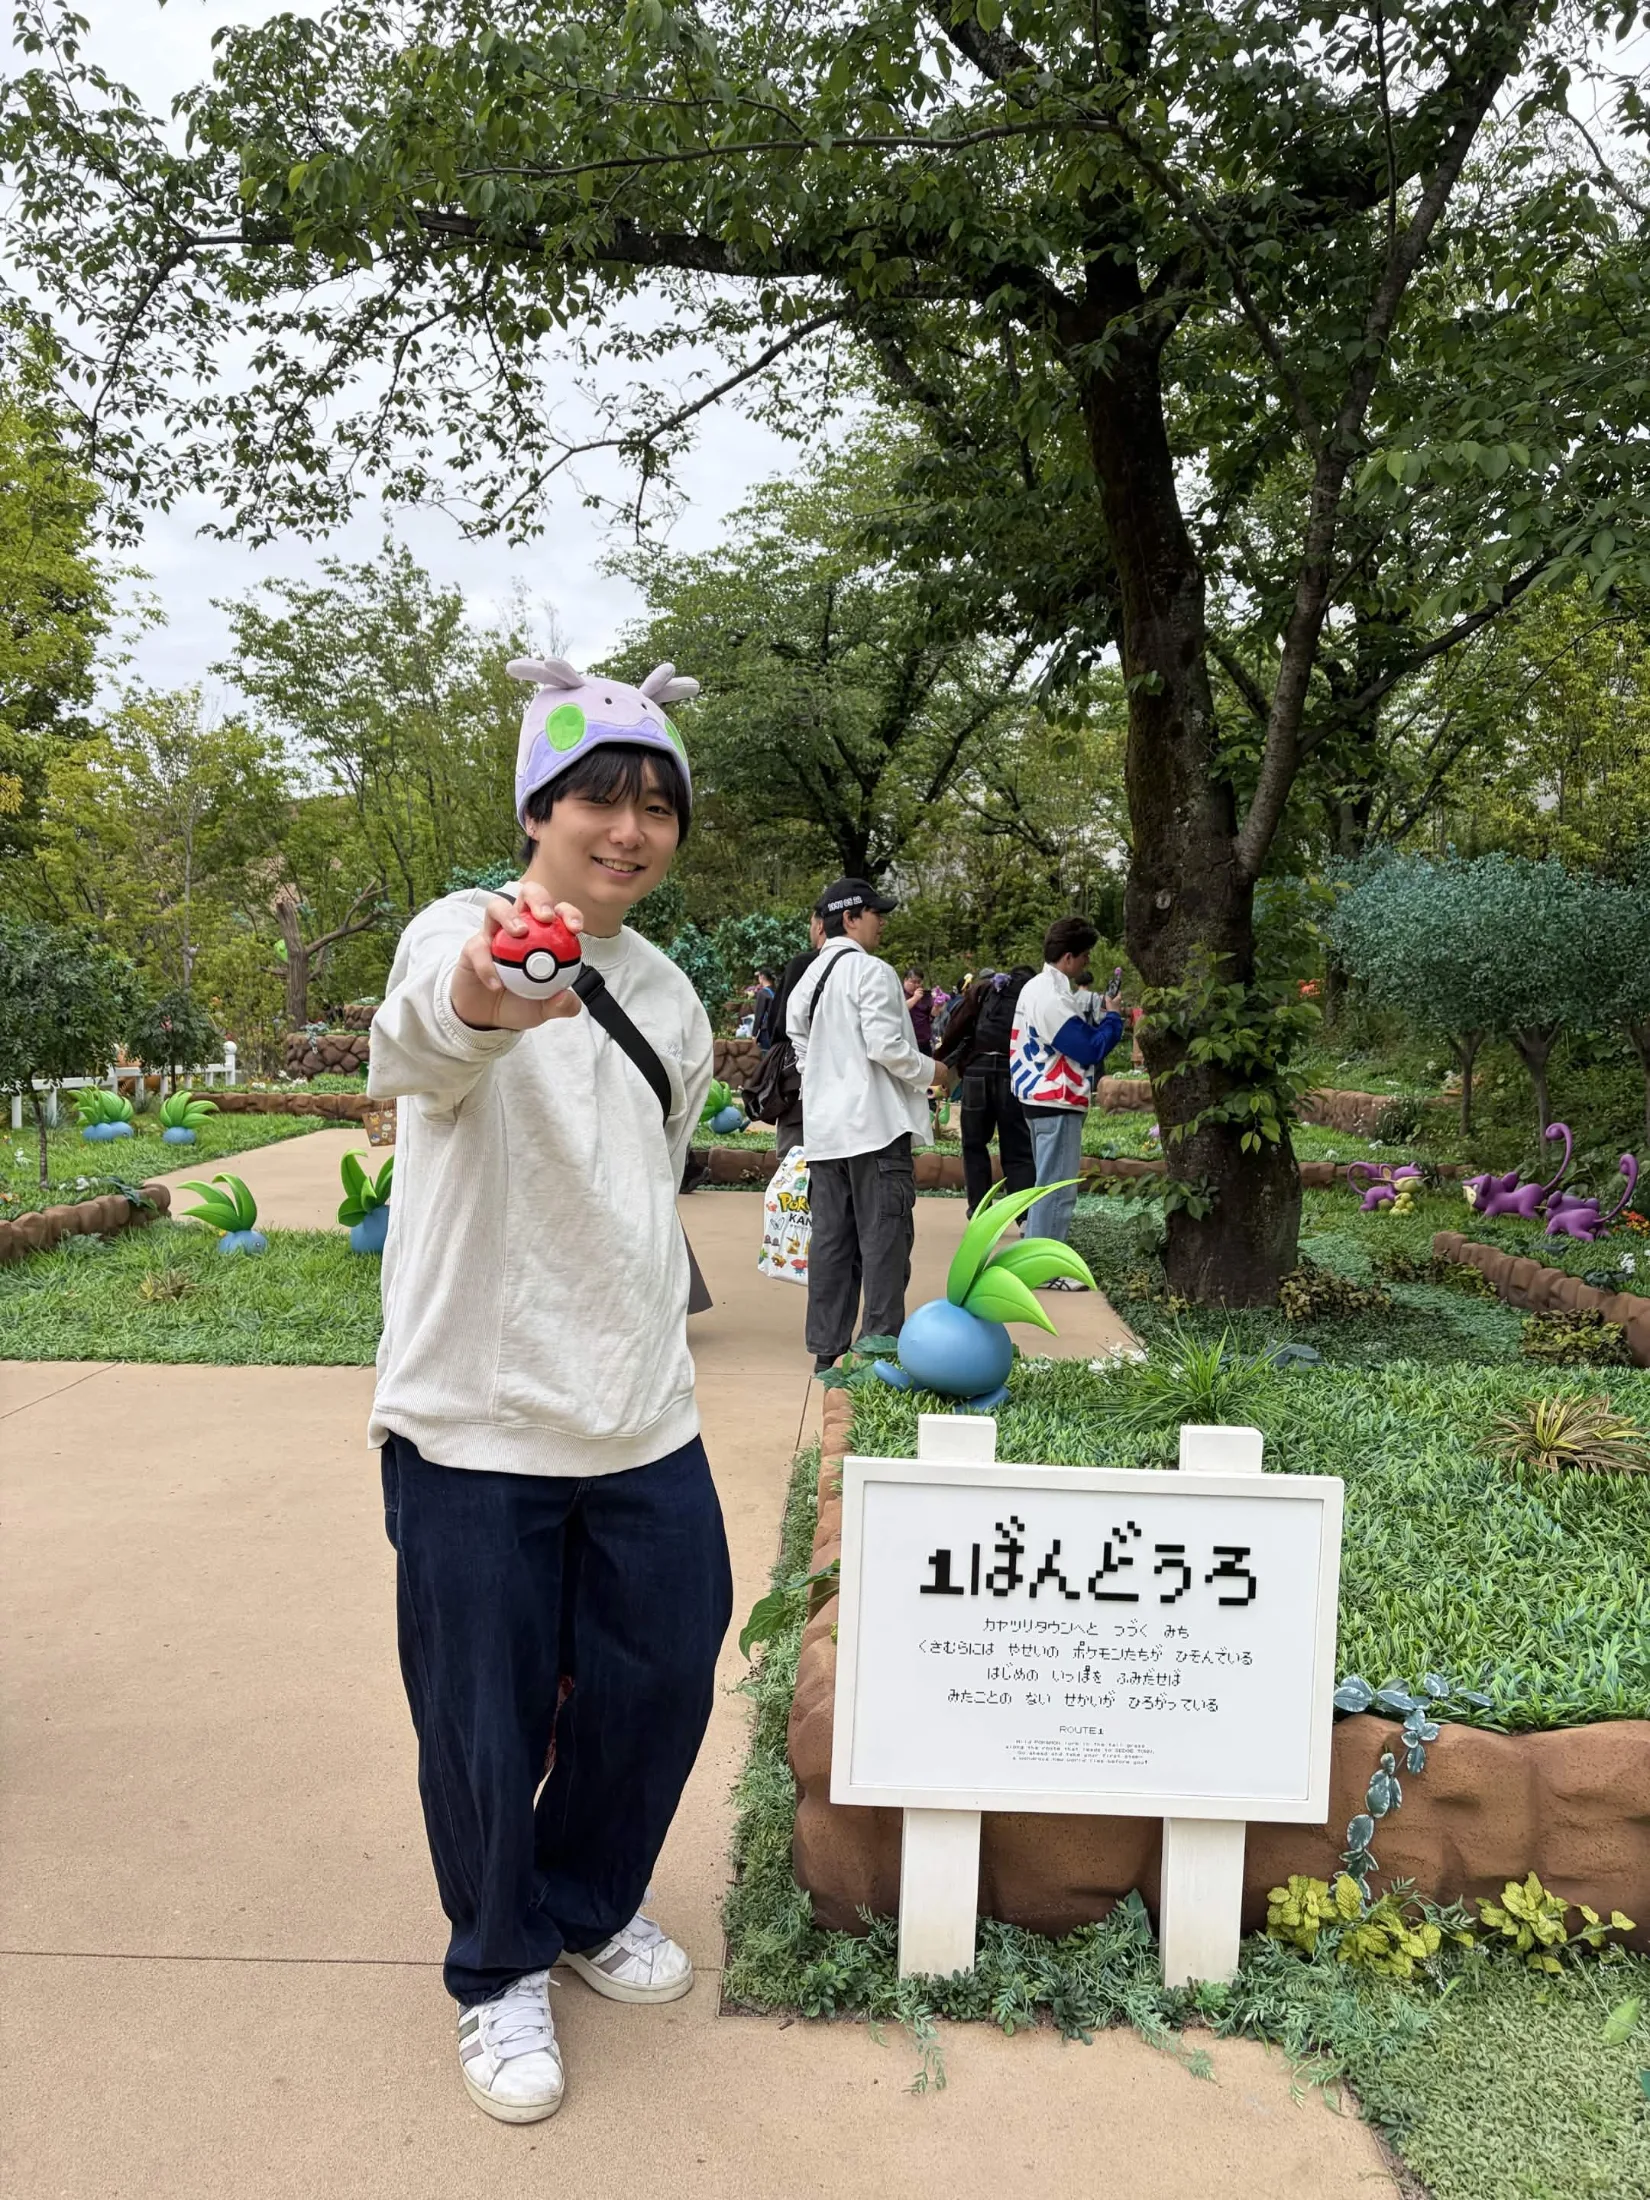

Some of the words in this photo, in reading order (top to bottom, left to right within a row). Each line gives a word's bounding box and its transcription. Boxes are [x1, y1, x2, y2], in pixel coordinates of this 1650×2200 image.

[919, 1515, 1257, 1606] 1ばんどうろ
[1113, 1618, 1149, 1638] つづく
[1163, 1624, 1190, 1640] みち
[918, 1639, 995, 1656] くさむらには
[1008, 1642, 1059, 1658] やせいの
[1072, 1640, 1163, 1662] ポケモンたちが
[1175, 1646, 1253, 1666] ひそんでいる
[987, 1661, 1039, 1681] はじめの
[1052, 1664, 1102, 1684] いっぽを
[1116, 1667, 1182, 1687] ふみだせば
[947, 1688, 1013, 1705] みたことの
[1025, 1691, 1051, 1706] ない
[1064, 1689, 1116, 1709] せかいが
[1127, 1691, 1219, 1713] ひろがっている
